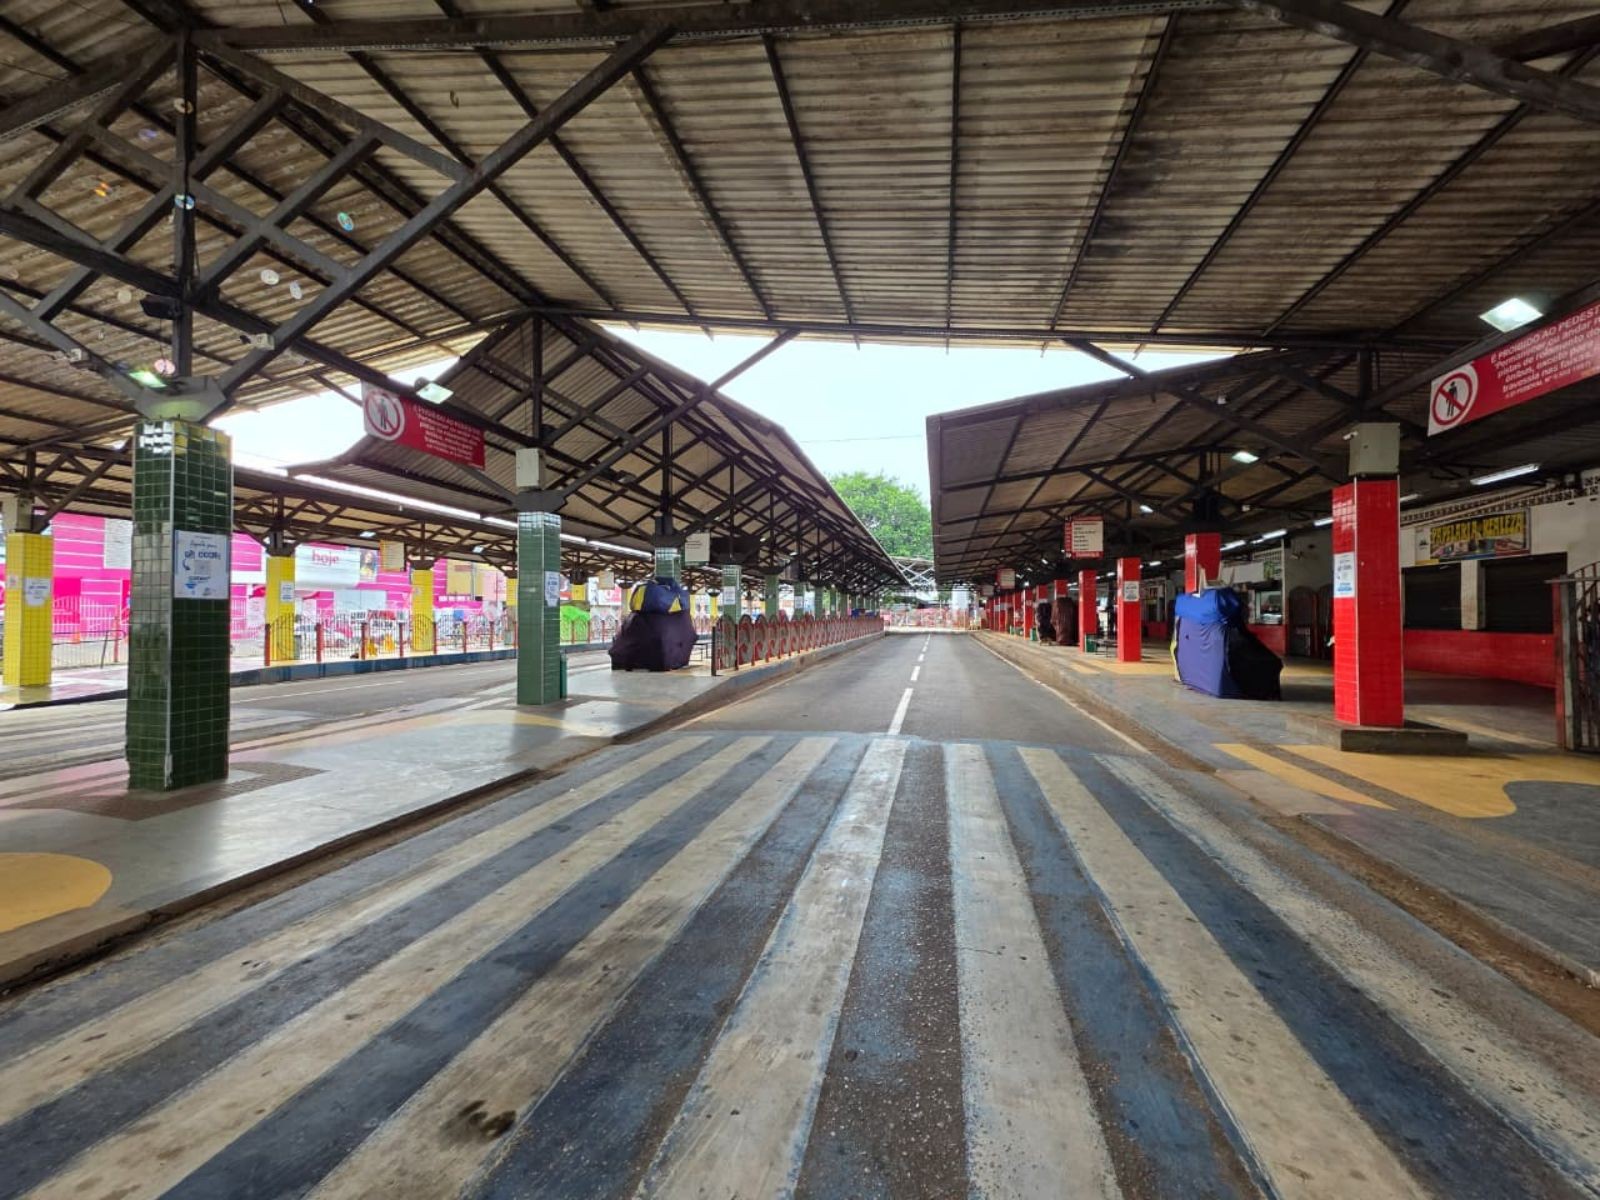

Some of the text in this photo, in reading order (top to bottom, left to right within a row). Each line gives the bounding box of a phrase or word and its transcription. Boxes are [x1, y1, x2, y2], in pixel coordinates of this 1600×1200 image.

[1498, 334, 1540, 358] PROIBIDO
[1541, 326, 1557, 339] AO
[312, 548, 339, 567] hoje
